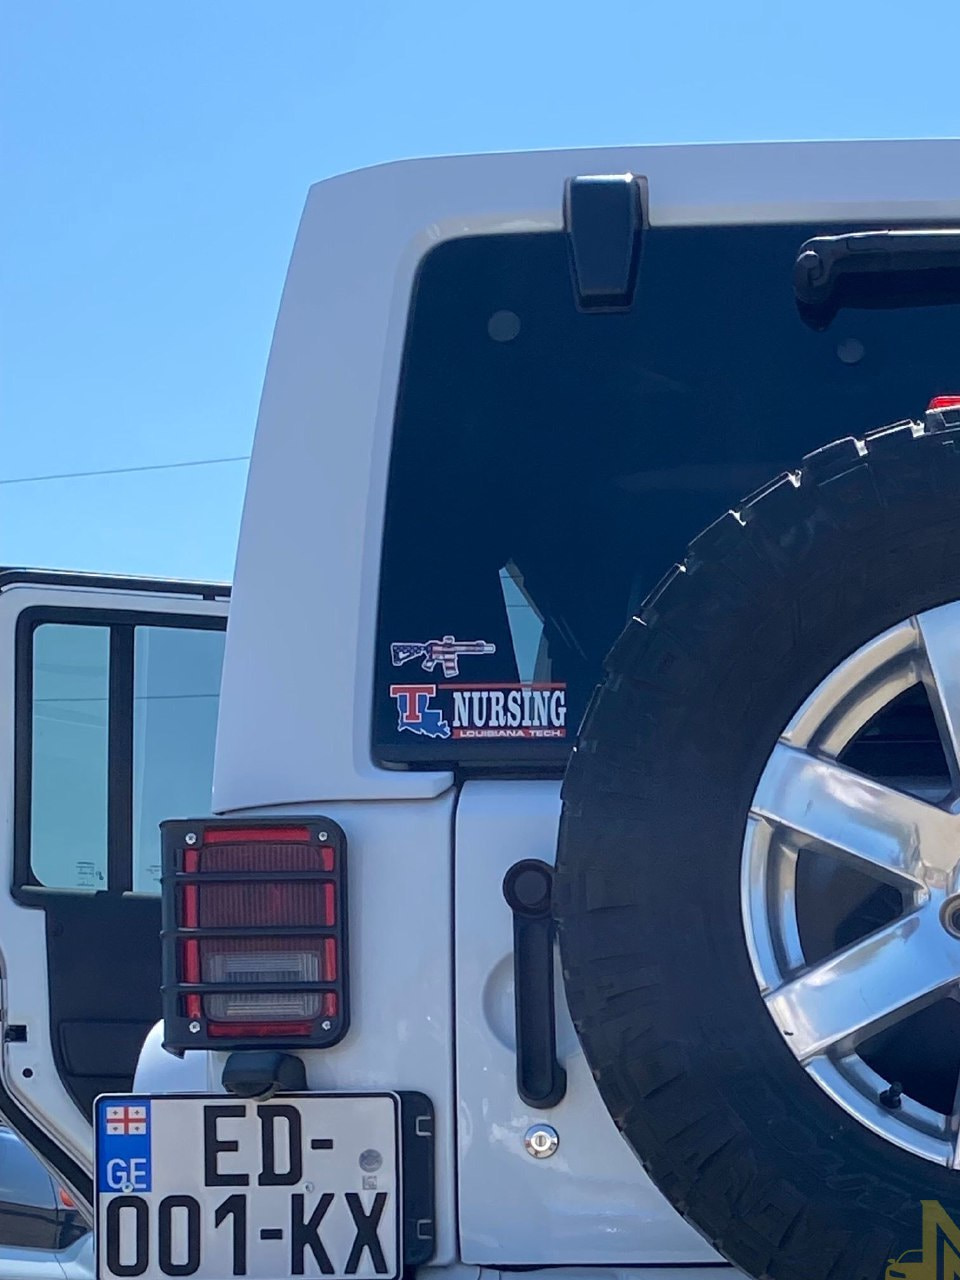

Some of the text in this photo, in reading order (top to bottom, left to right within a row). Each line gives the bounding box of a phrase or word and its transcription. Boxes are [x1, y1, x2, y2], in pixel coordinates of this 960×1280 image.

[453, 691, 566, 727] NURSING
[460, 729, 525, 738] LOUISIANA
[106, 1158, 147, 1189] GE
[106, 1192, 389, 1277] 001-KX
